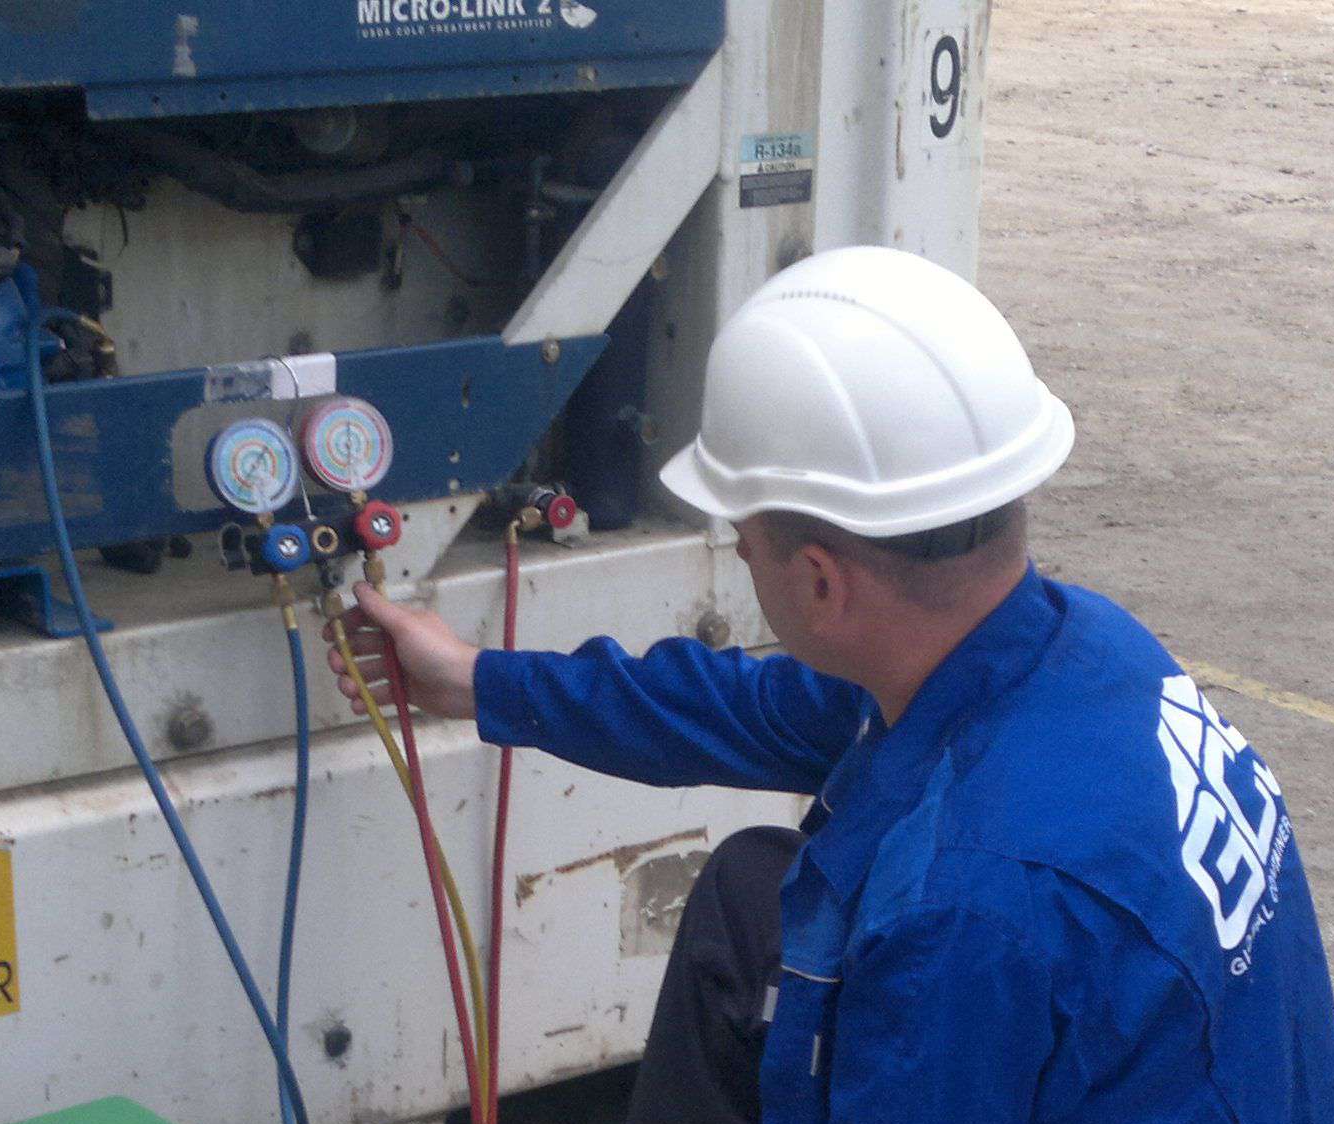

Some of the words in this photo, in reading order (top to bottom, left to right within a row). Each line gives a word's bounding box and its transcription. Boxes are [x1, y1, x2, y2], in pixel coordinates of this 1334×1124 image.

[396, 25, 426, 36] COLD
[929, 35, 961, 138] 9
[754, 142, 802, 159] R-134a
